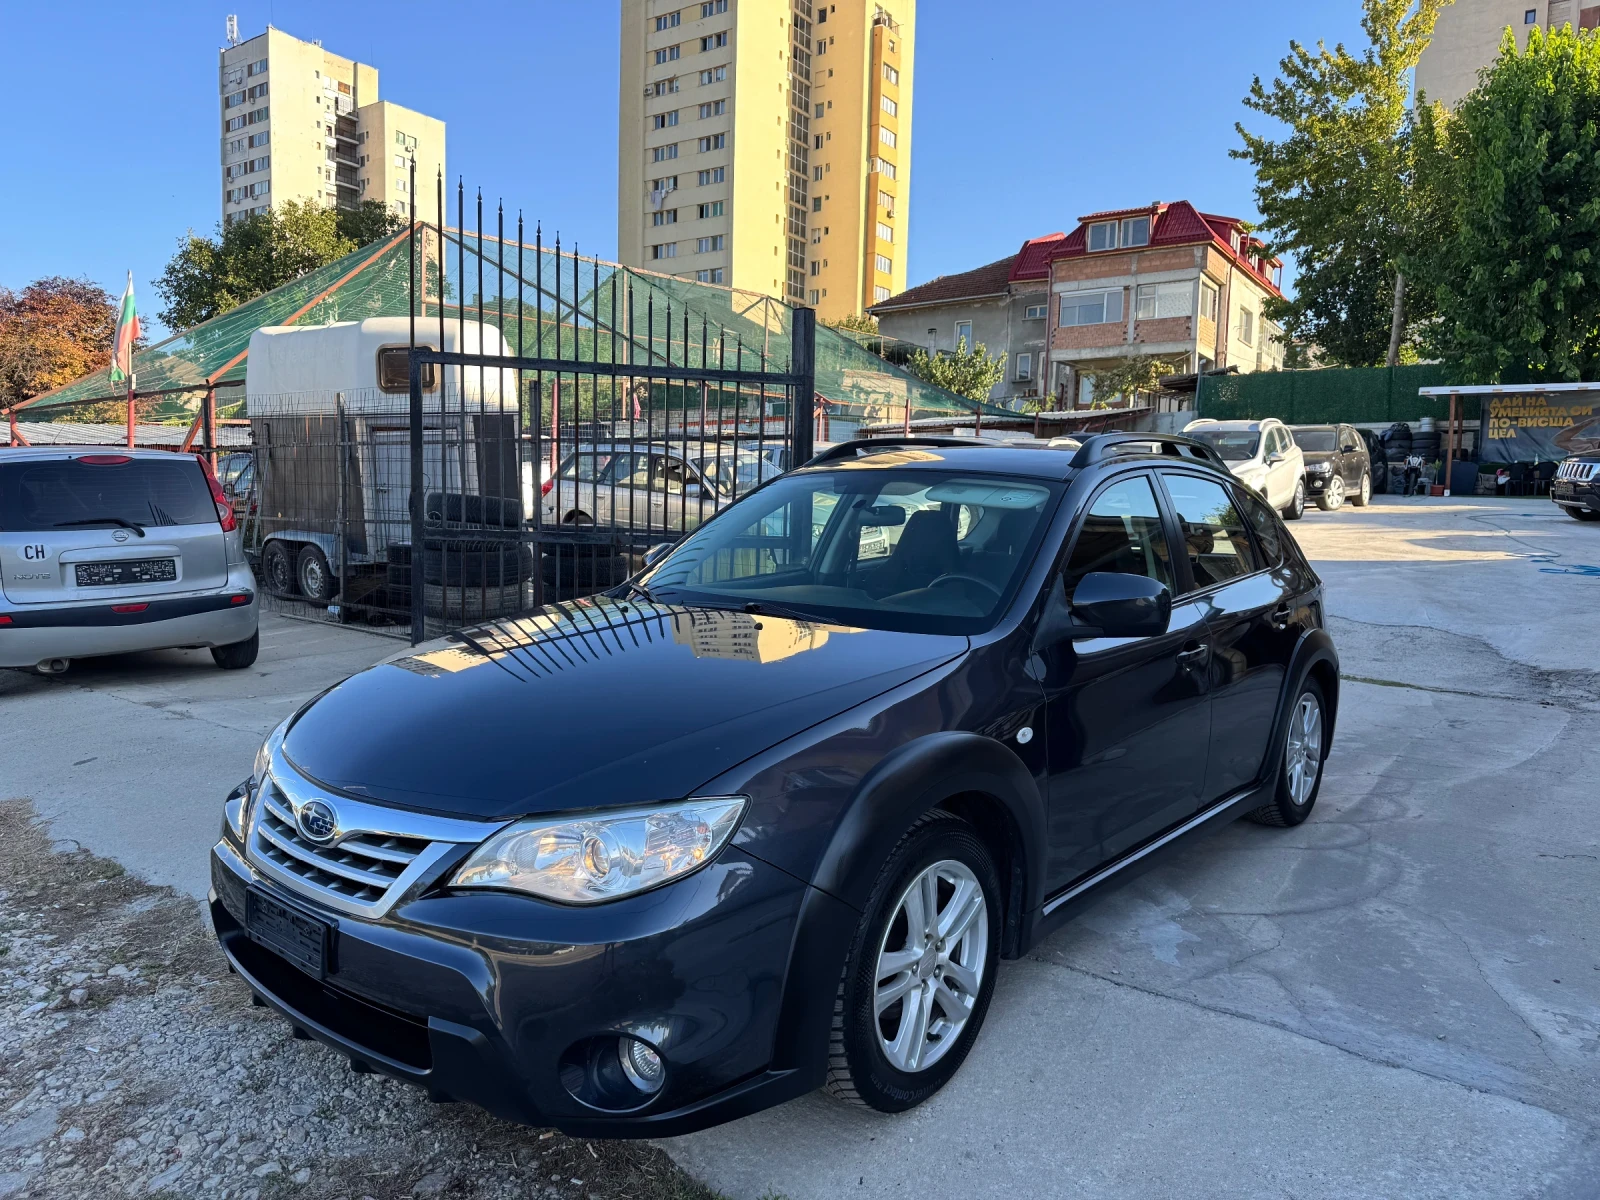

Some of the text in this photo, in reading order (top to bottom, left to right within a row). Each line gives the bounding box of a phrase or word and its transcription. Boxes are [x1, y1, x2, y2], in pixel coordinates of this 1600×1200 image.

[1490, 395, 1547, 407] ДАЙ НА
[1490, 406, 1592, 417] УМЕНИЯТА СИ
[1489, 417, 1574, 428] ПО-ВИСША
[1488, 428, 1516, 439] ЦЕЛ
[24, 544, 46, 560] CH
